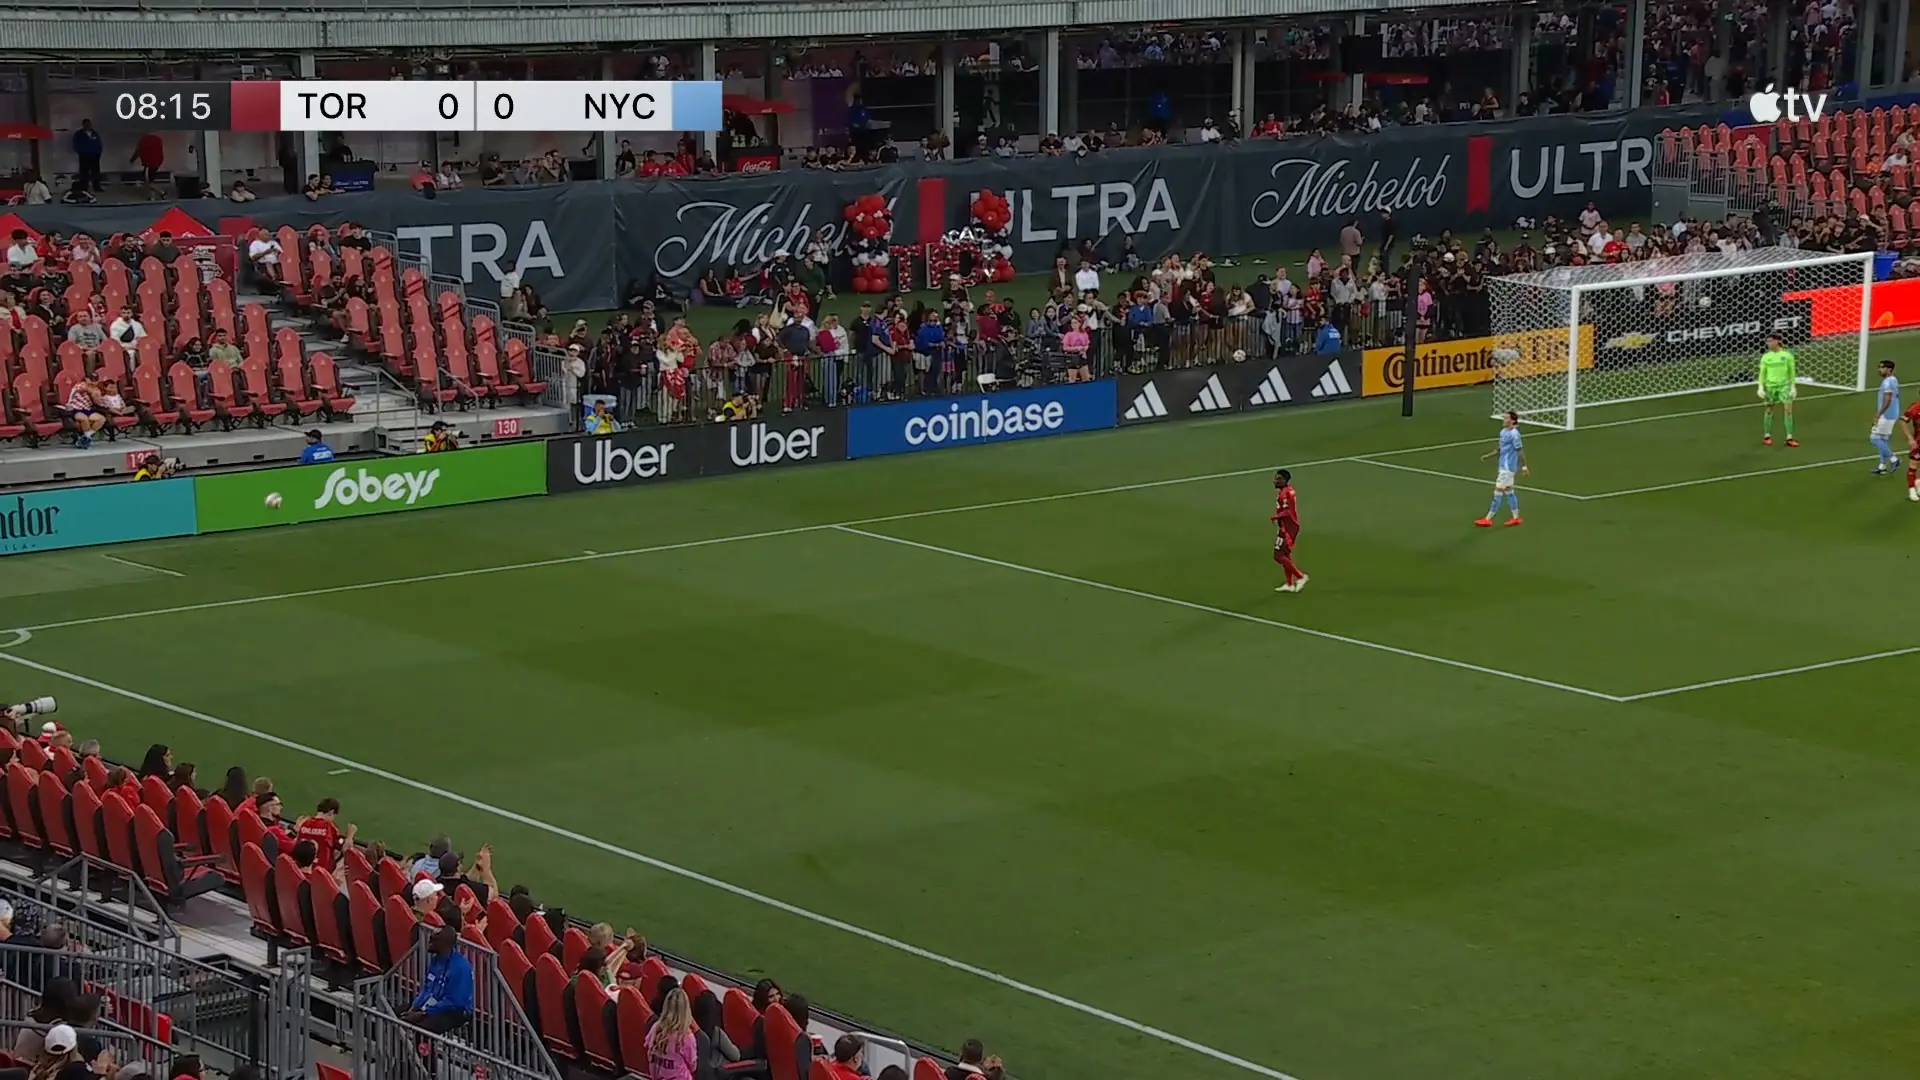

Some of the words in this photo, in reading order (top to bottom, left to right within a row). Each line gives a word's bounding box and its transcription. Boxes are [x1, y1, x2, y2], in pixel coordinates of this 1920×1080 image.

[1251, 153, 1450, 227] Michelob
[654, 197, 898, 278] Michel
[1667, 316, 1803, 342] CHEVROET
[1383, 346, 1504, 388] Continenta
[498, 420, 517, 434] 130
[904, 399, 1064, 445] coinbase
[130, 452, 153, 468] 12
[573, 440, 675, 484] Uber
[730, 423, 825, 467] Uber
[314, 467, 440, 510] Sobeys
